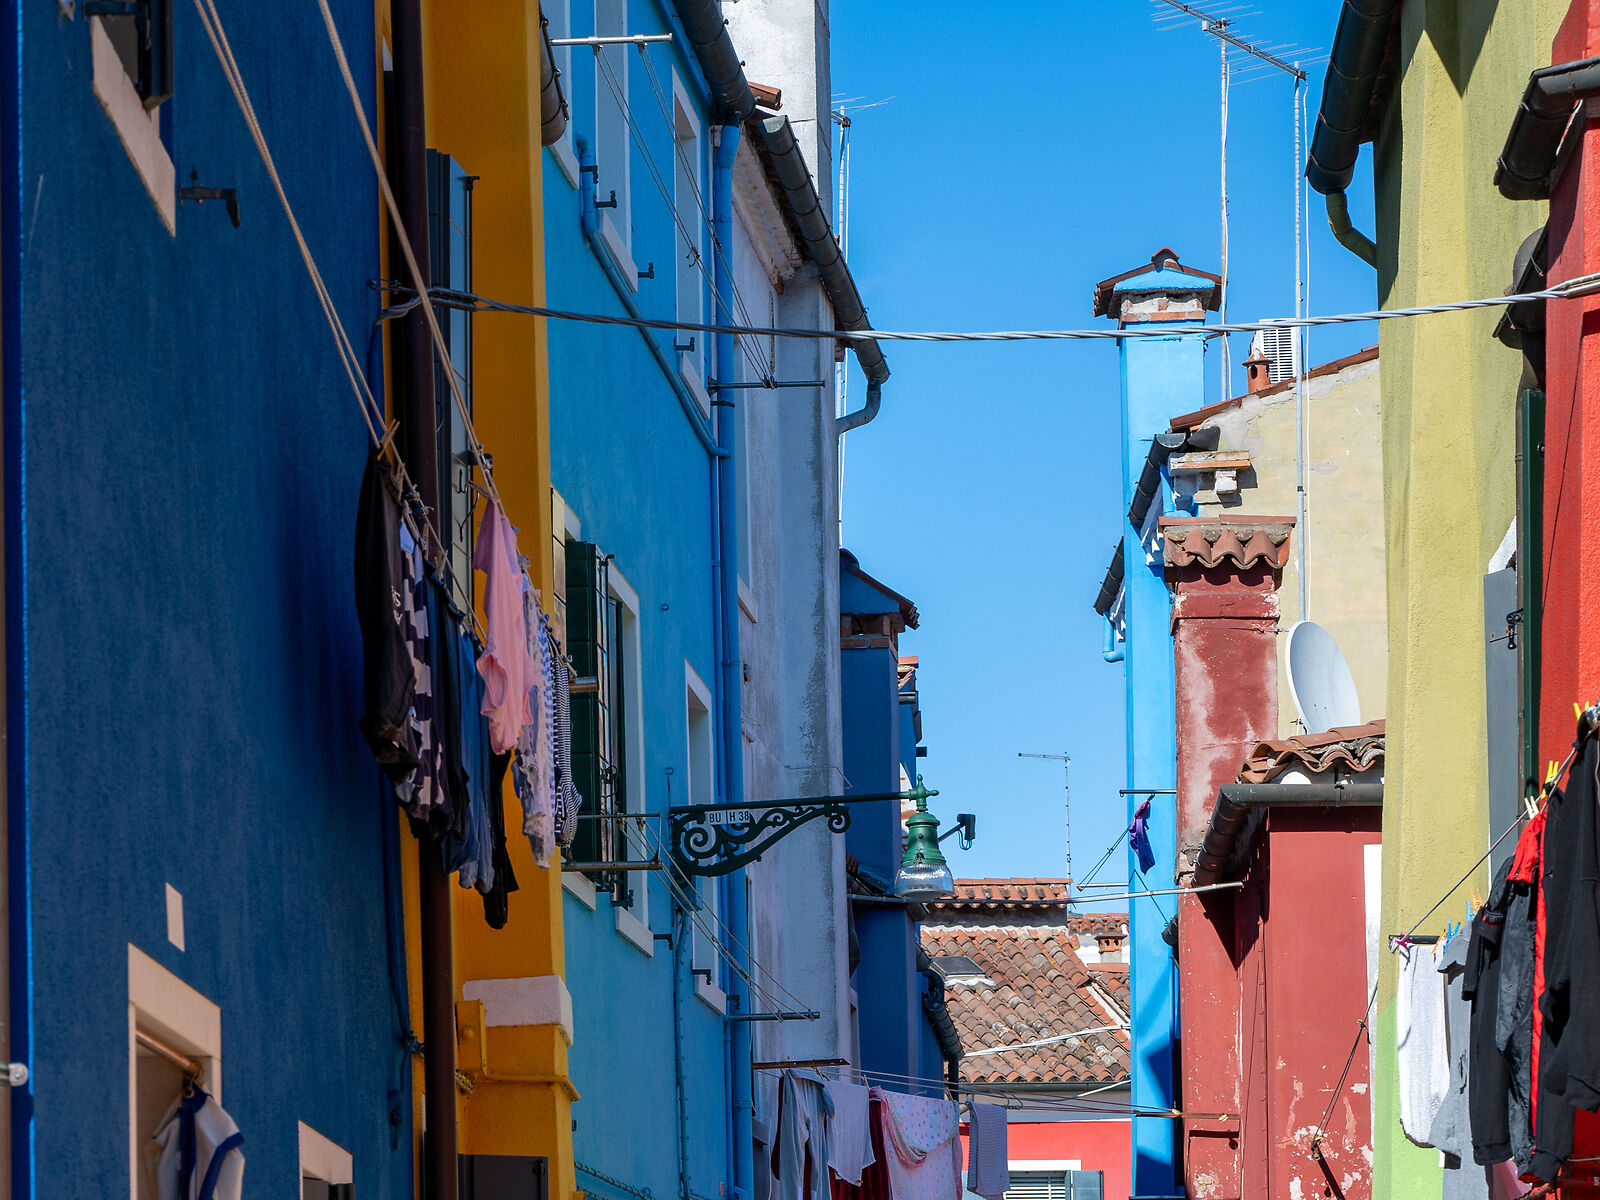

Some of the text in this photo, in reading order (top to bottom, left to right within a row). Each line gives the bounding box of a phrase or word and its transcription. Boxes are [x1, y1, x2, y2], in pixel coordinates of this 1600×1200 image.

[709, 811, 750, 823] BU H 38
